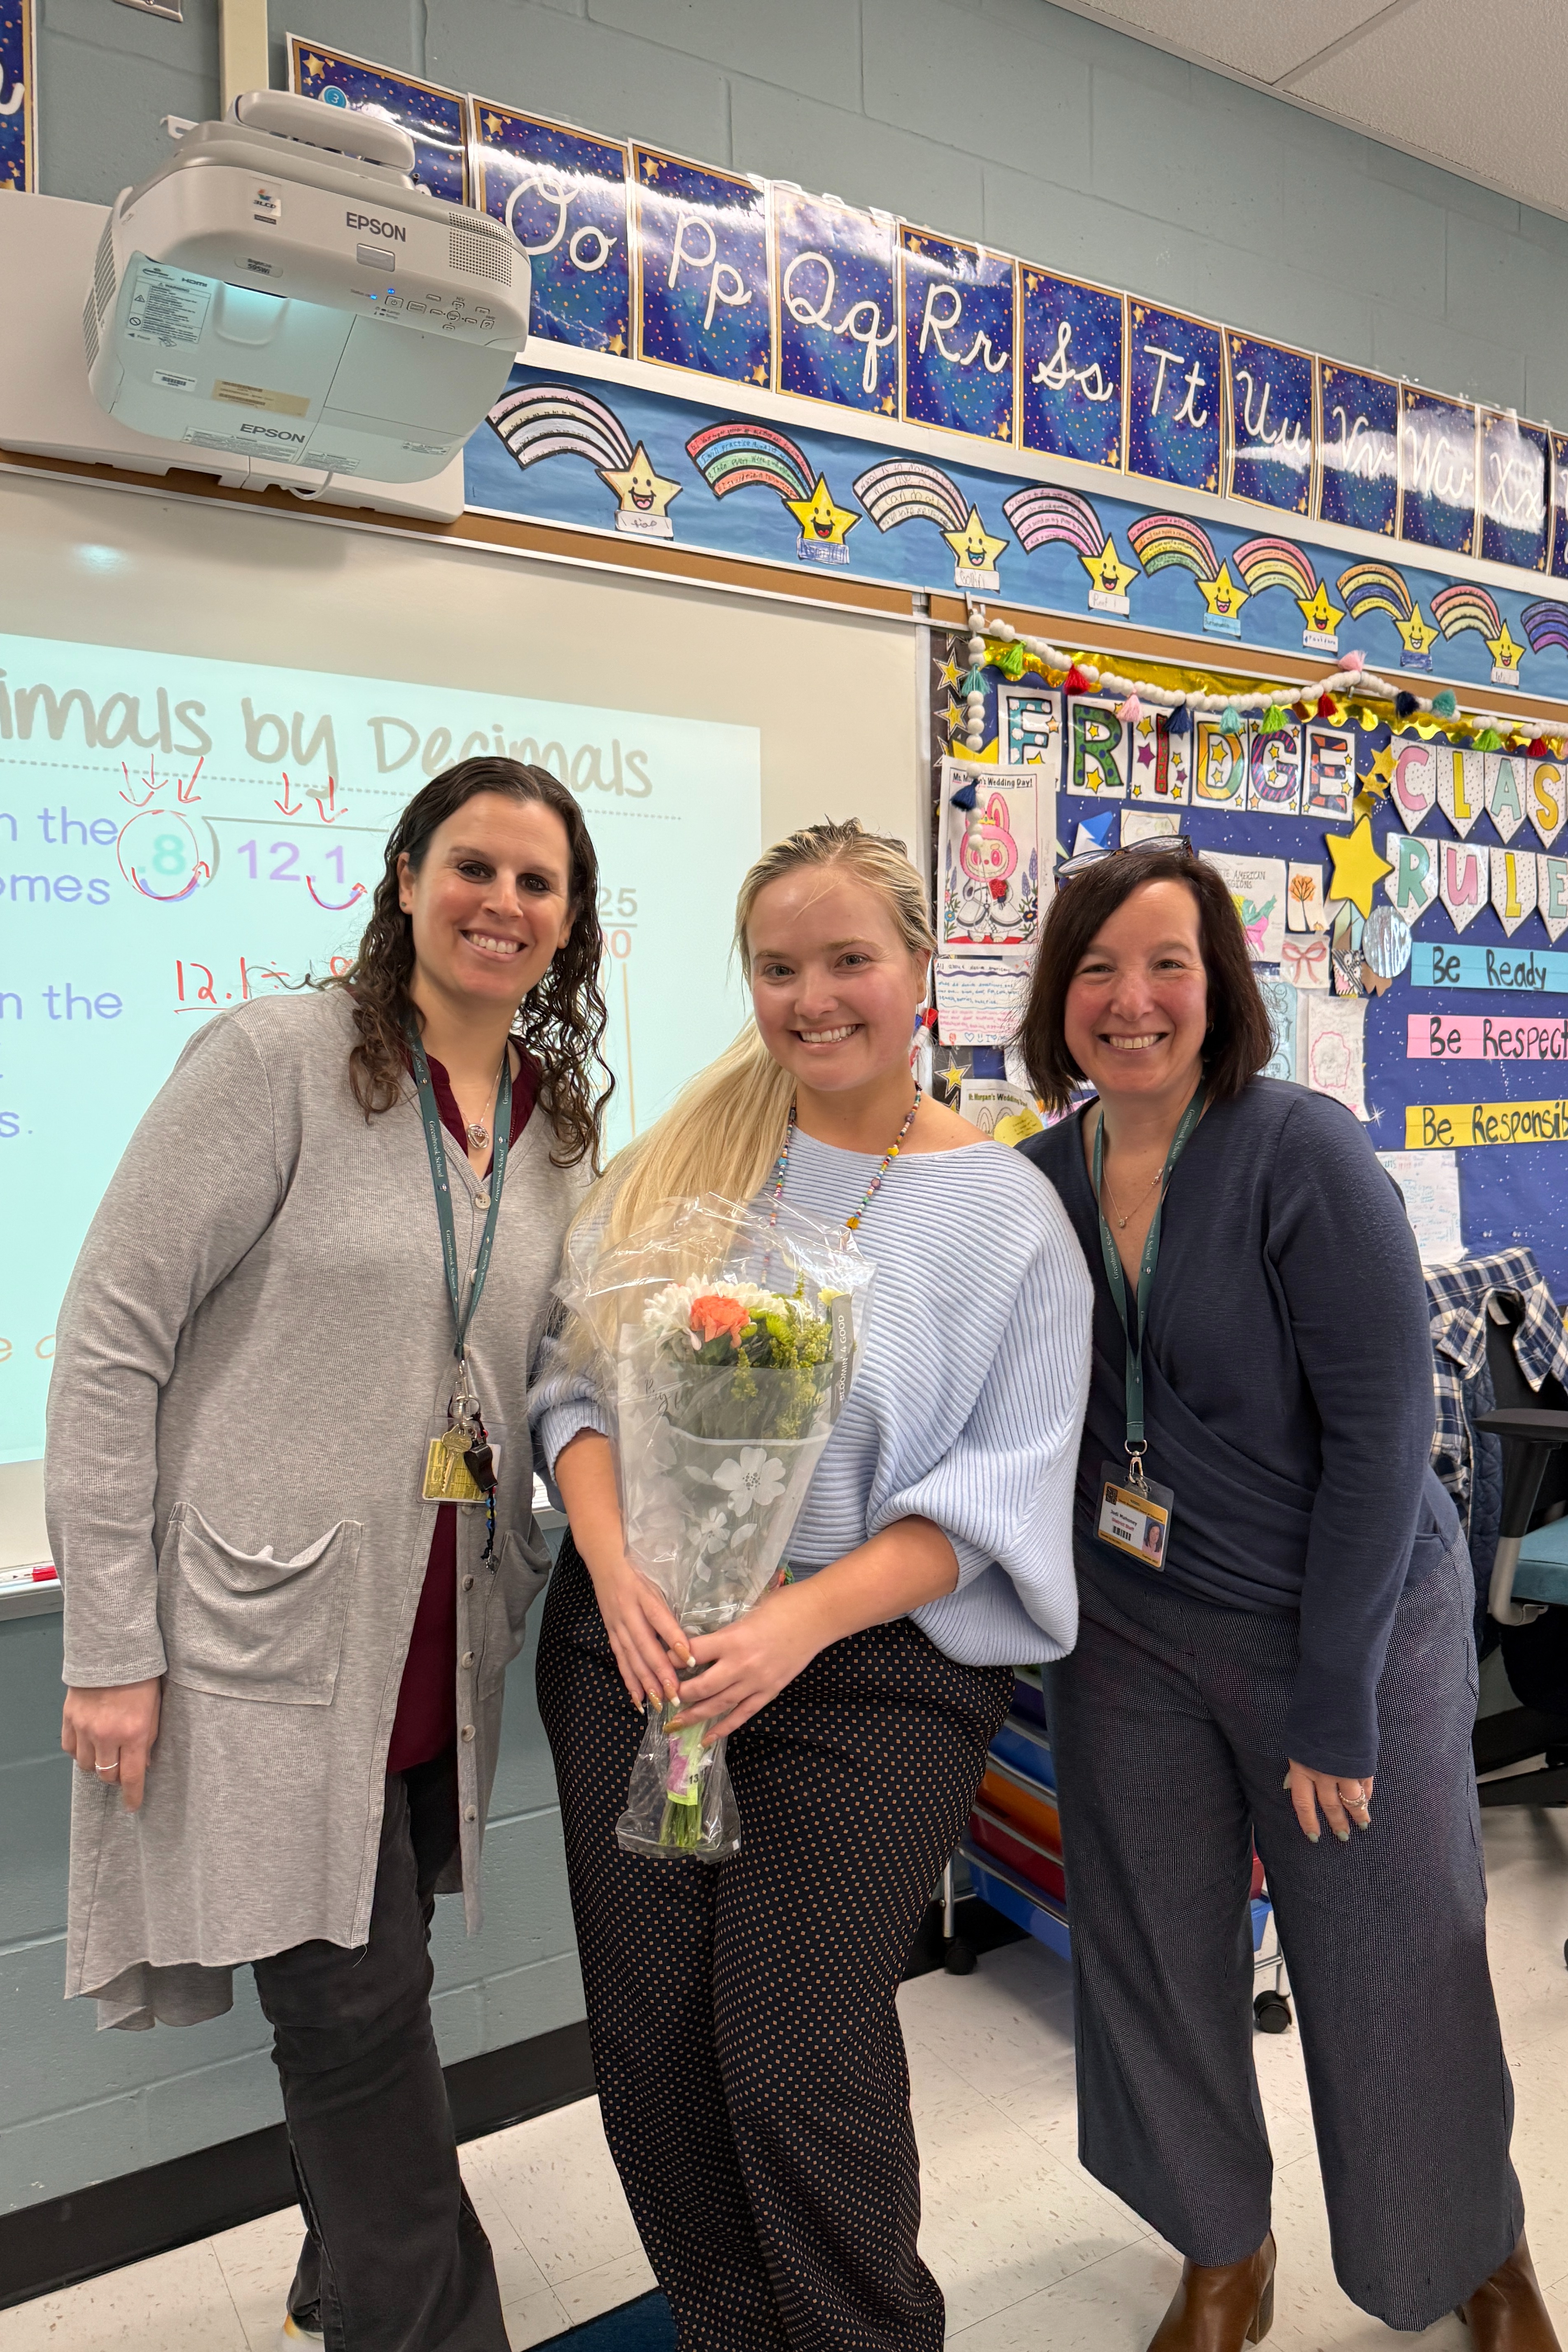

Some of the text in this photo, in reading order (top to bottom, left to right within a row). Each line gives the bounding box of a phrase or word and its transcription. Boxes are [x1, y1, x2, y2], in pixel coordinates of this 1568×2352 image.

[346, 211, 406, 243] EPSON
[506, 175, 616, 272] Oo
[182, 278, 208, 287] HDMI
[668, 212, 751, 329] Pp
[784, 252, 898, 393] Qq
[919, 284, 1007, 373] Rr
[1032, 322, 1113, 401] Ss
[1144, 345, 1207, 427] Tt
[240, 423, 306, 443] EPSON
[1237, 371, 1311, 457] Uu
[1333, 406, 1394, 474] Vv
[241, 697, 339, 800] by
[367, 716, 653, 798] Decimals
[1007, 697, 1347, 814] FRIDGE
[988, 777, 1015, 788] Wedding
[1017, 778, 1033, 787] Day!
[38, 806, 119, 845] the
[0, 875, 110, 905] mes
[1234, 870, 1266, 880] AMERICAN
[1433, 945, 1547, 991] Be Ready
[42, 982, 123, 1020] the
[1430, 1016, 1462, 1057] Be
[974, 1093, 995, 1102] Morgan's
[1171, 1109, 1195, 1159] Greenbrook School
[1422, 1107, 1454, 1146] Be
[429, 1120, 444, 1177] Greenbrook School
[495, 1168, 503, 1202] Greenbrook
[446, 1230, 454, 1267] Greenbrook
[1108, 1247, 1119, 1279] Greenbrook
[1145, 1241, 1154, 1260] School
[838, 1315, 847, 1344] GOOD
[839, 1356, 849, 1402] BLOOMIN'
[688, 1773, 699, 1784] 13
